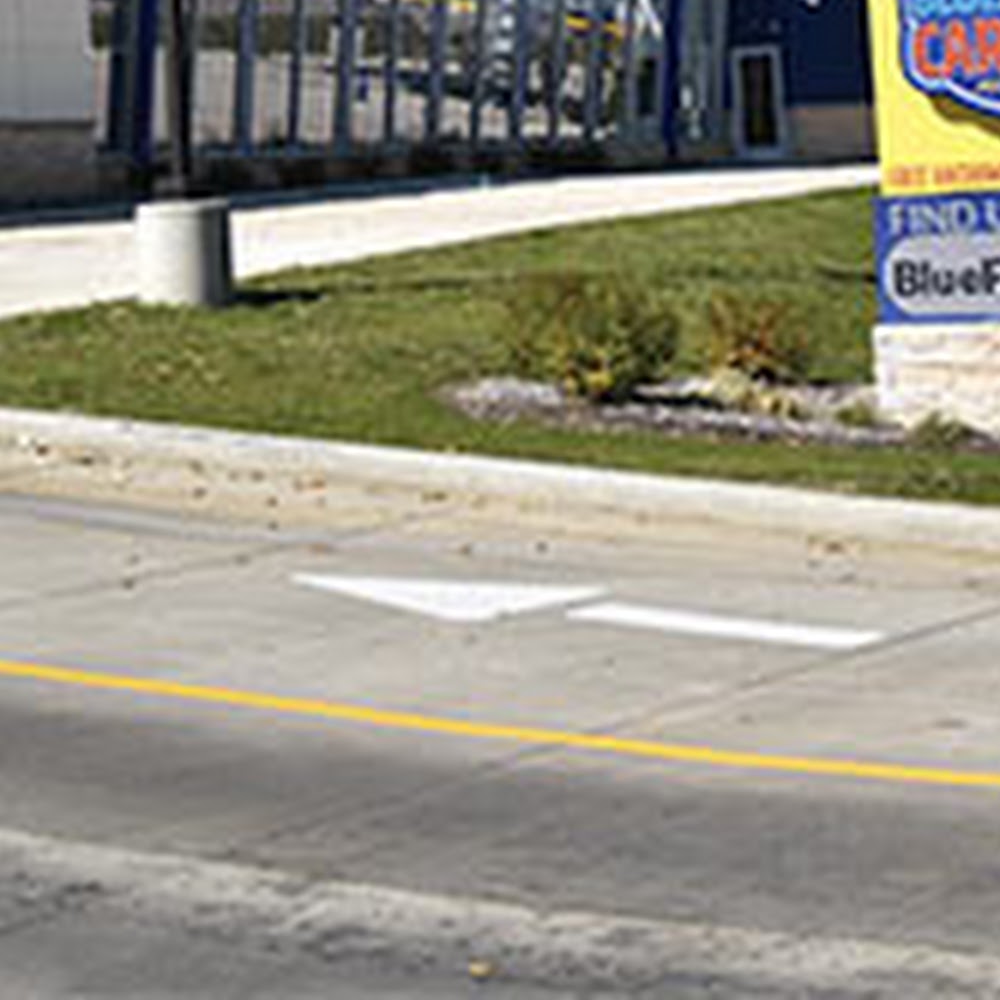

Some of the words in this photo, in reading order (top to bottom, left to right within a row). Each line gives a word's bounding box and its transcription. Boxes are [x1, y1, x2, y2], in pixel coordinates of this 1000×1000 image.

[914, 18, 1000, 79] CAR
[889, 200, 978, 234] FIND
[894, 257, 1000, 297] BlueF
